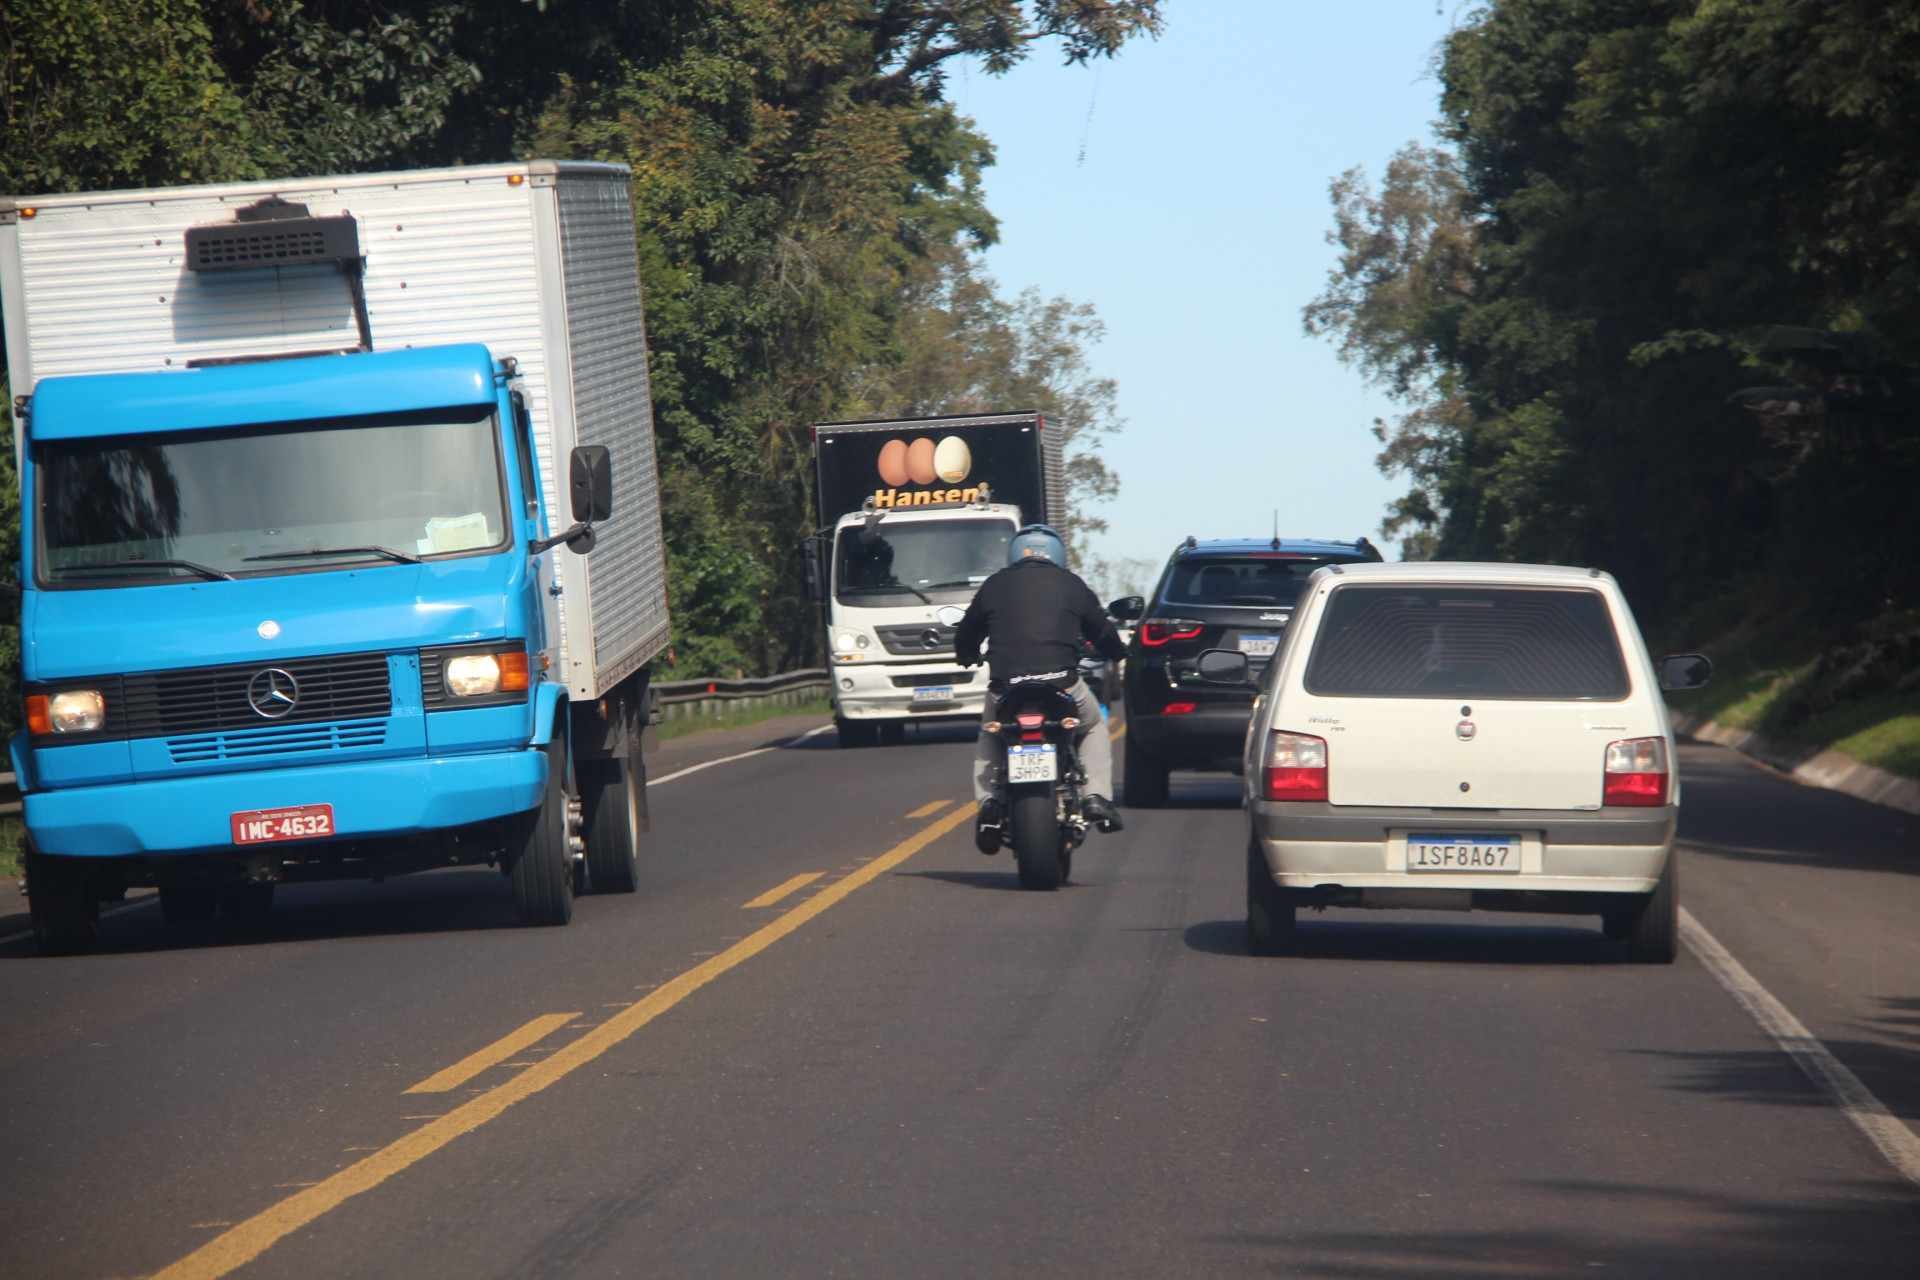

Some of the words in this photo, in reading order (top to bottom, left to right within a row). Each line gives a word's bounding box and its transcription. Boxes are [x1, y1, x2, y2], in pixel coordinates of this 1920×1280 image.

[875, 488, 979, 507] Hansen
[240, 815, 329, 840] IMC-4632
[1417, 845, 1509, 866] ISF8A67
